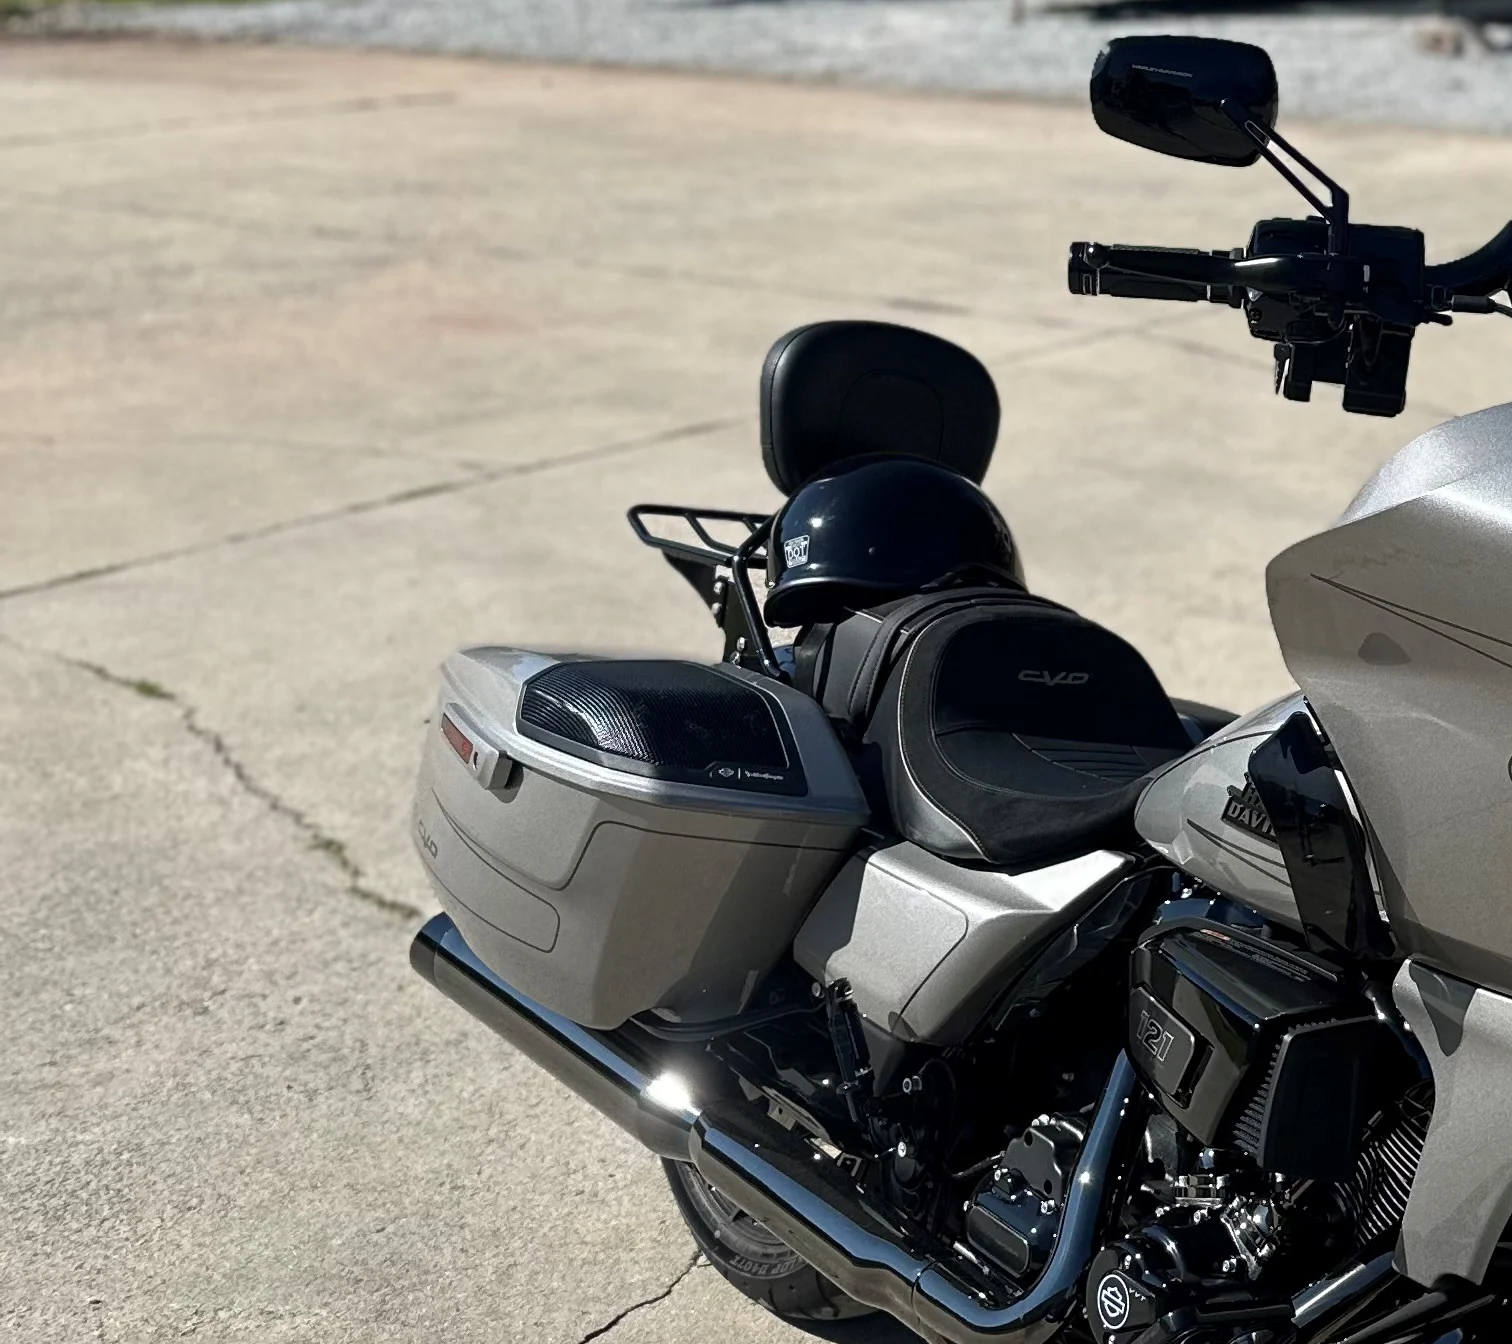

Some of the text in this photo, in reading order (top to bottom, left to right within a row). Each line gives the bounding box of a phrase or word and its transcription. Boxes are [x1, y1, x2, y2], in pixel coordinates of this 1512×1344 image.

[1018, 669, 1089, 686] CVO
[1227, 799, 1277, 837] DAVI
[1136, 1009, 1175, 1062] 121
